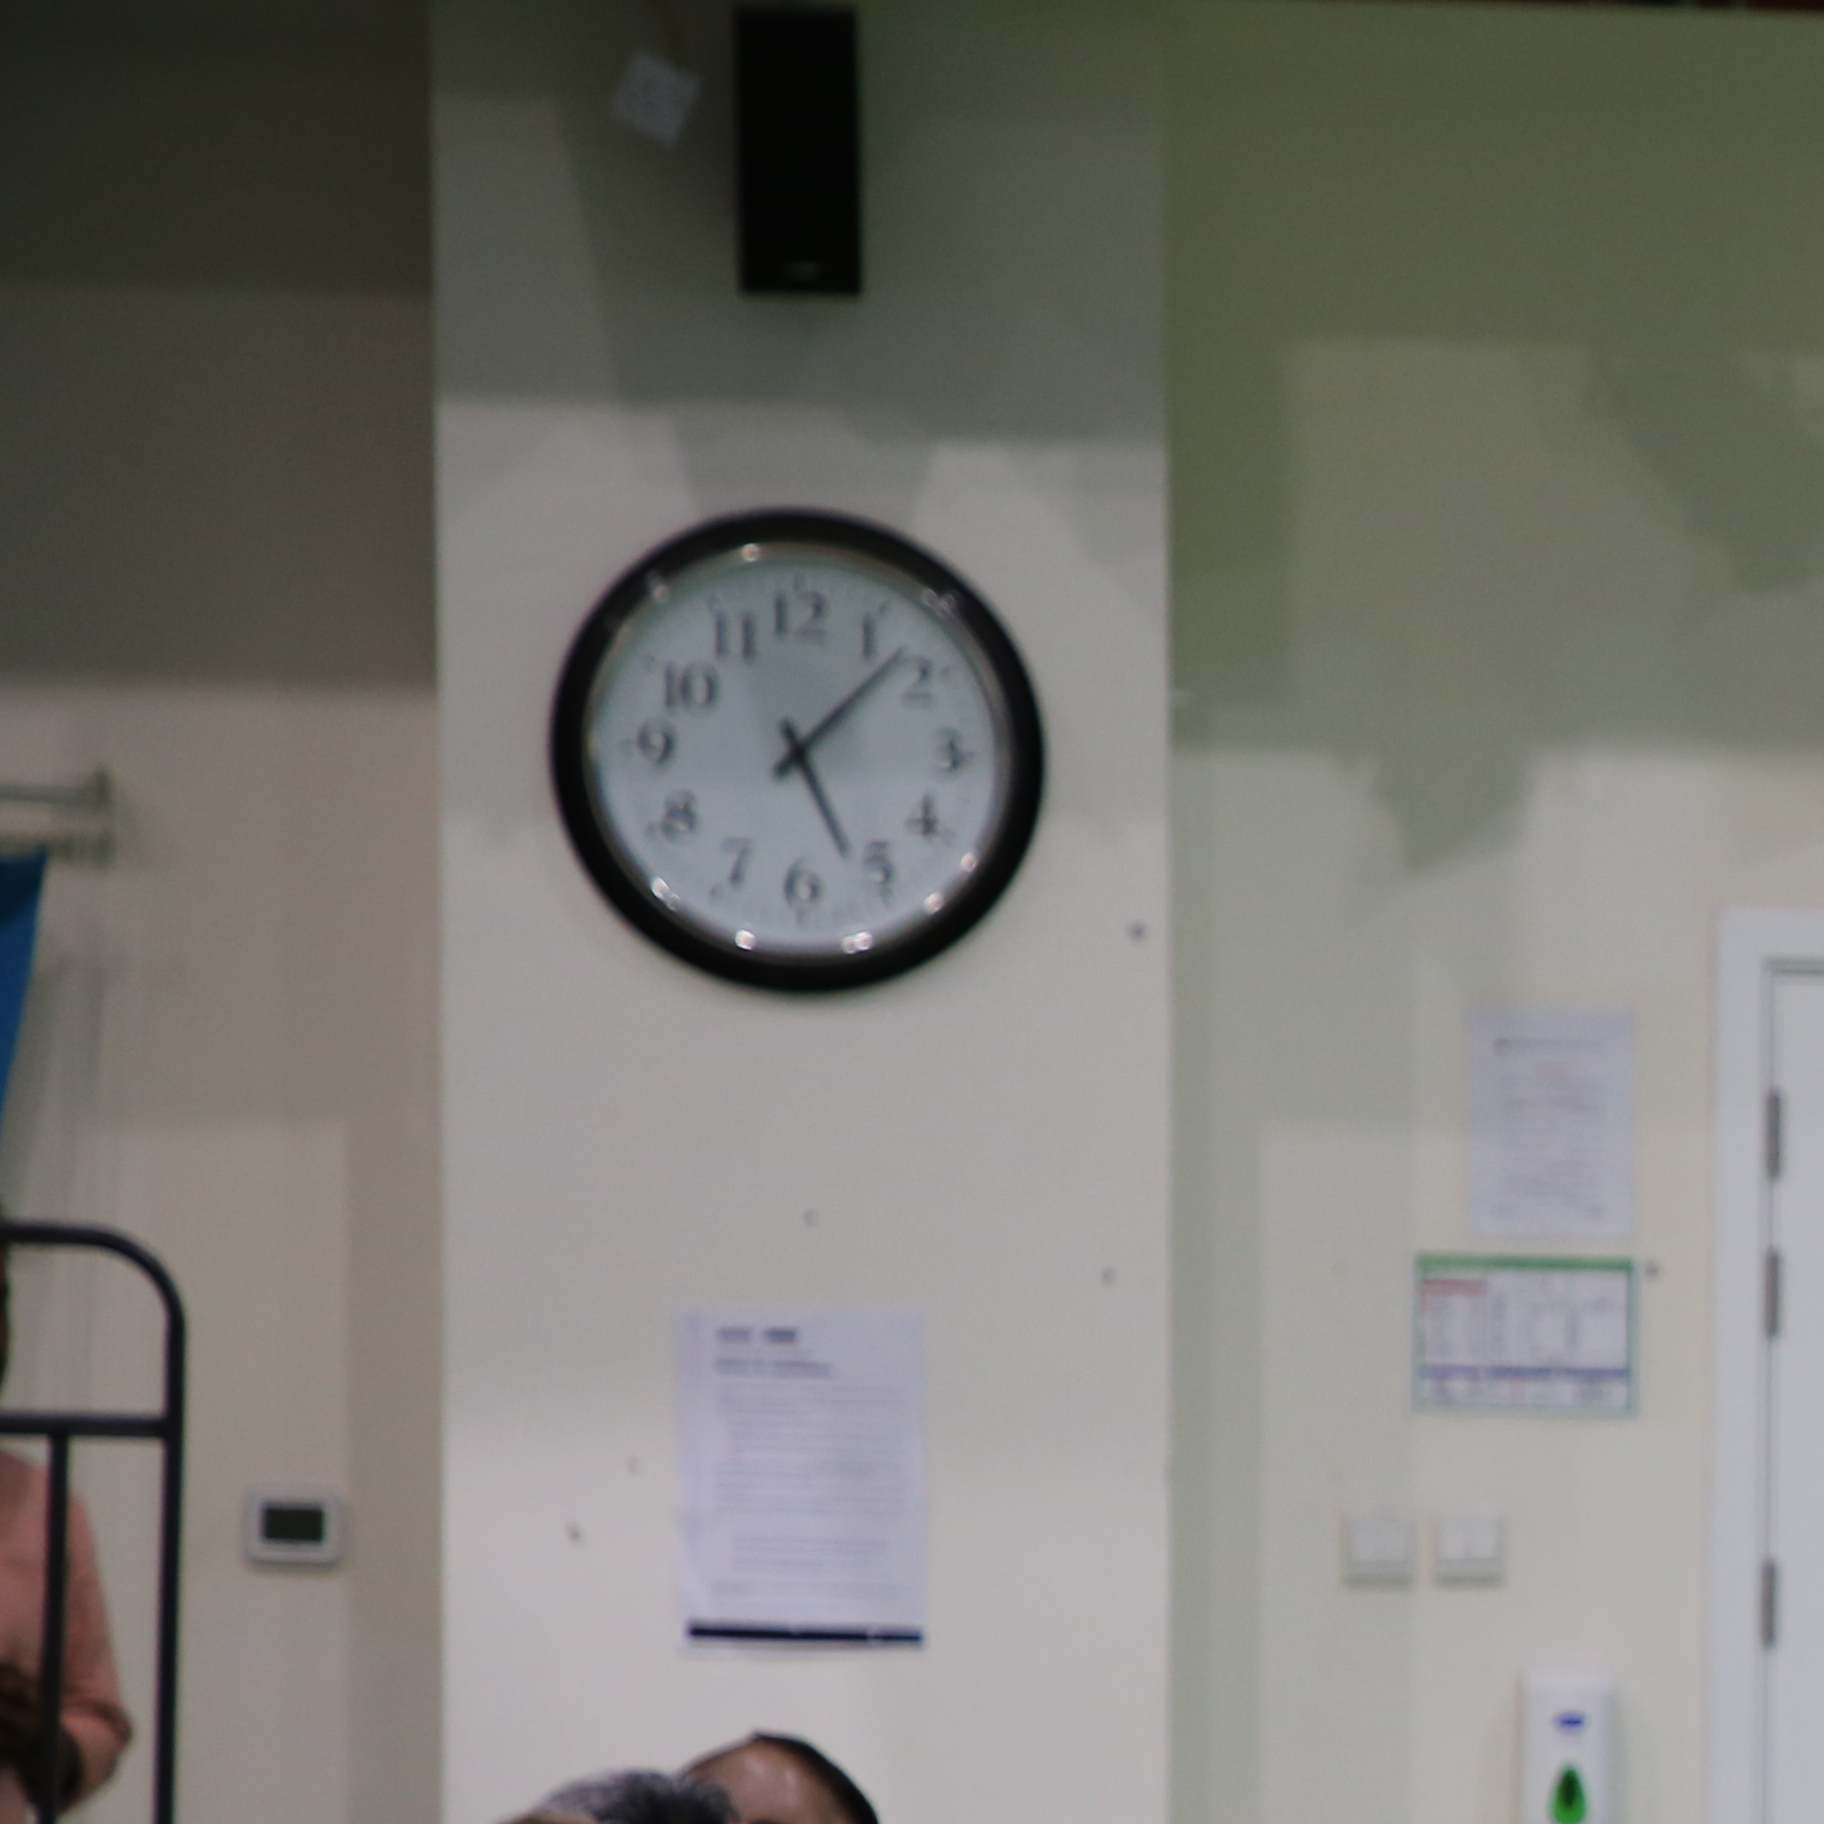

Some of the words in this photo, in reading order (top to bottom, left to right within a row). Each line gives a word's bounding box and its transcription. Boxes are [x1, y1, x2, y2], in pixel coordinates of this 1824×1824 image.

[713, 608, 757, 662] 11
[773, 591, 827, 641] 12
[664, 662, 718, 712] 10
[901, 655, 934, 707] 2
[637, 718, 675, 769] 9
[936, 727, 965, 775] 3
[661, 790, 696, 842] 8
[907, 794, 940, 839] 4
[720, 837, 752, 886] 7
[783, 858, 823, 908] 6
[863, 840, 896, 896] 5
